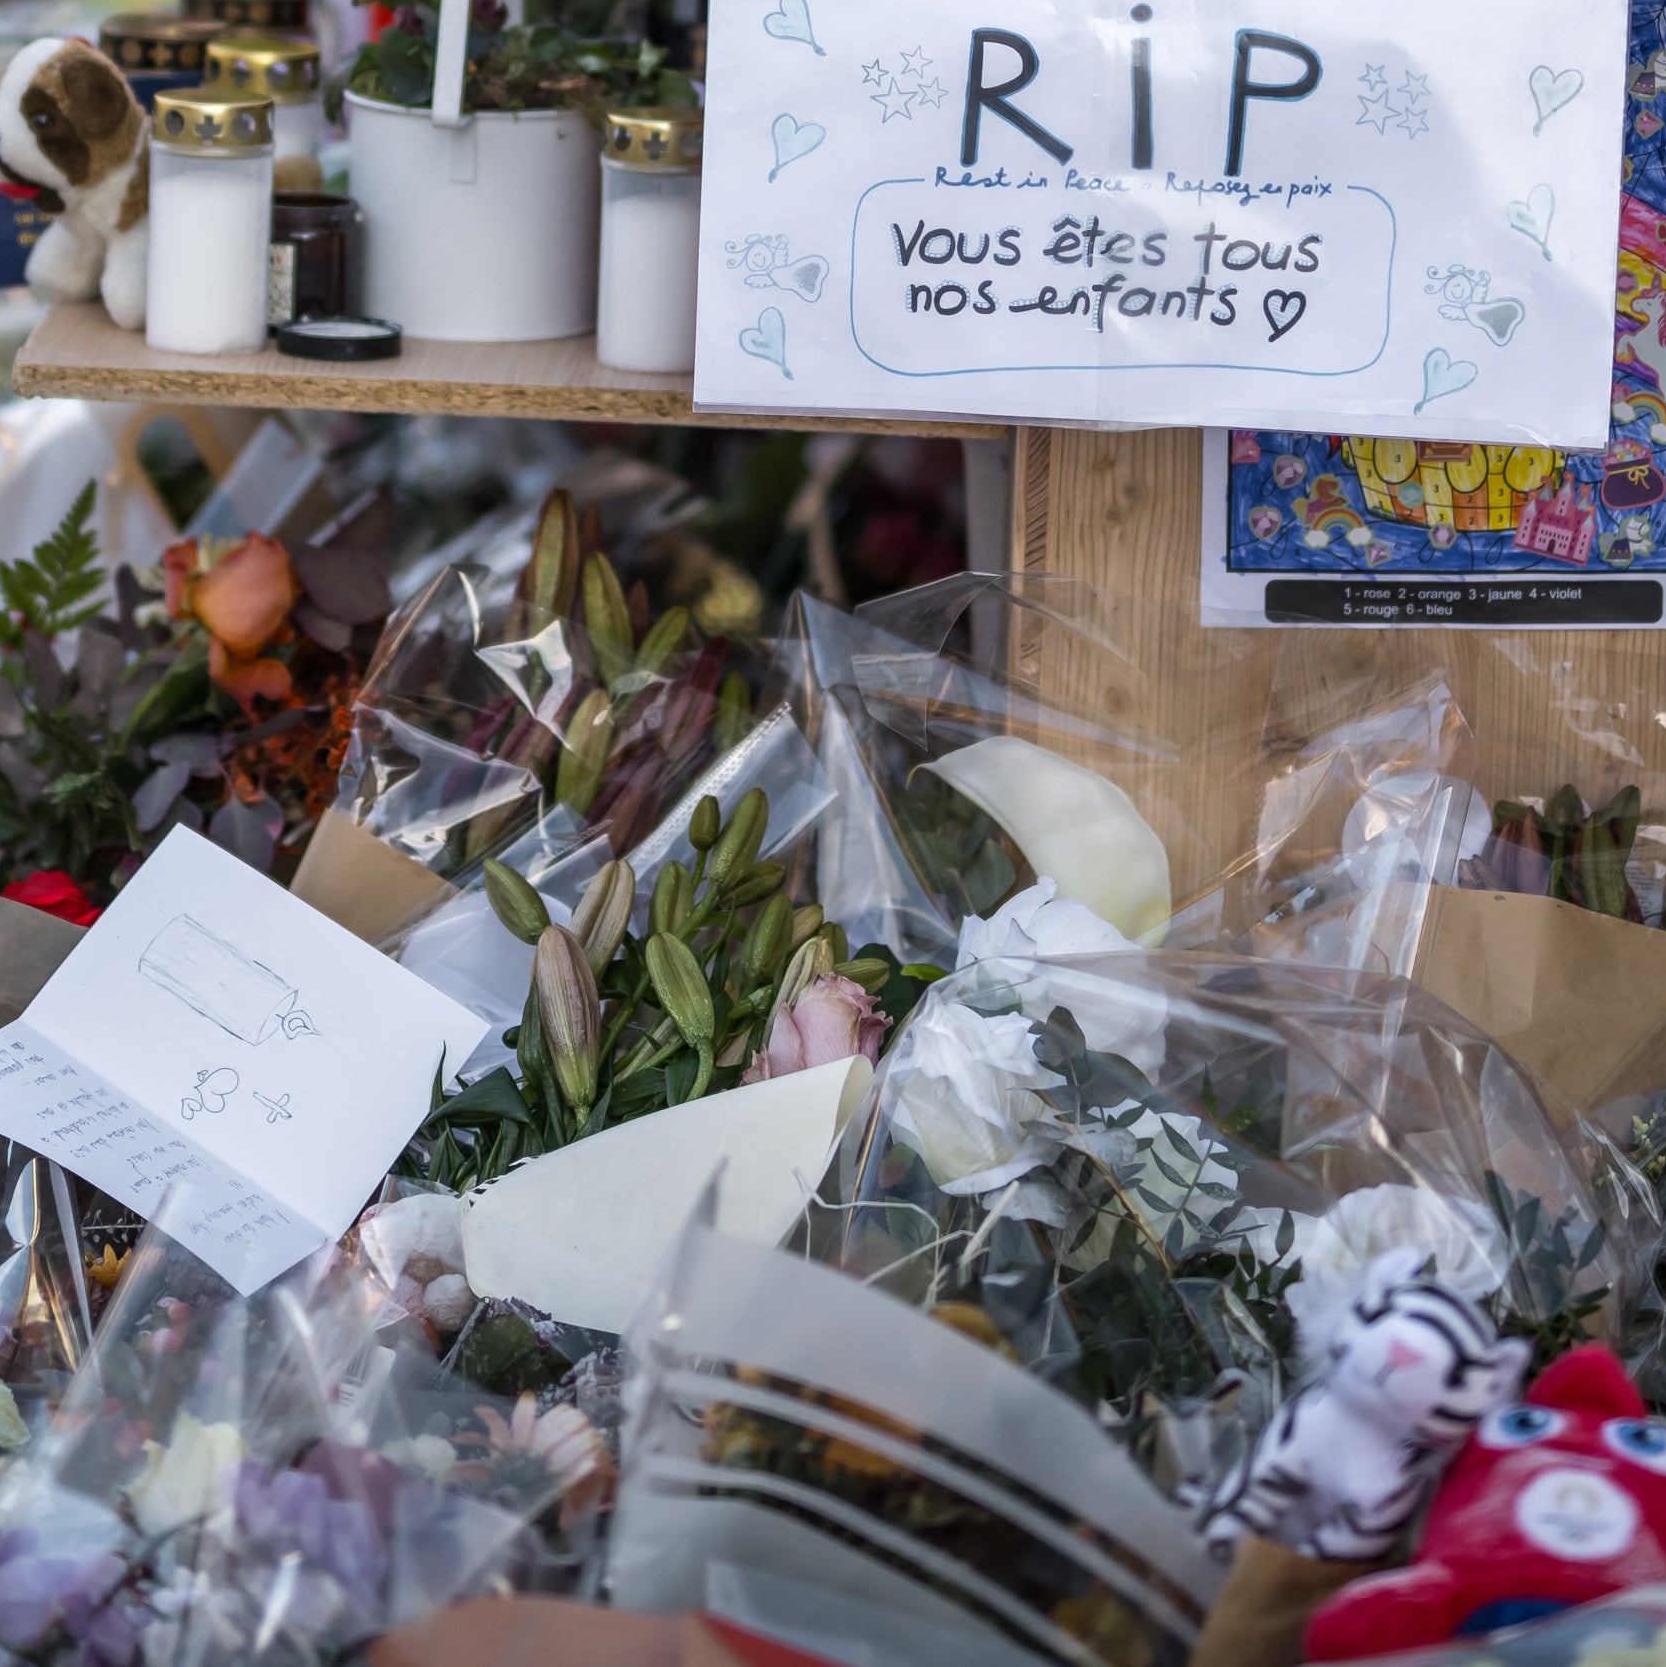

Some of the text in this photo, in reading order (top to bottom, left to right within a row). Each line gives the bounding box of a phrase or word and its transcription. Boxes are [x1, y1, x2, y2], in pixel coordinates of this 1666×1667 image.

[935, 165, 1333, 208] Rest in Peace Reposez en paix
[1043, 214, 1167, 267] êtes
[1194, 220, 1323, 275] tous
[905, 272, 1239, 333] nos enfants
[1344, 604, 1352, 614] 5
[1363, 605, 1399, 618] rouge
[1406, 604, 1414, 615] 6
[1426, 604, 1453, 615] bleu
[1345, 588, 1350, 598] 1
[1363, 590, 1391, 599] rose
[1398, 589, 1407, 599] 2
[1418, 590, 1461, 602] orange
[1469, 589, 1477, 599] 3
[1488, 589, 1522, 603] jaune
[1529, 589, 1537, 599] 4
[1549, 589, 1582, 599] violet
